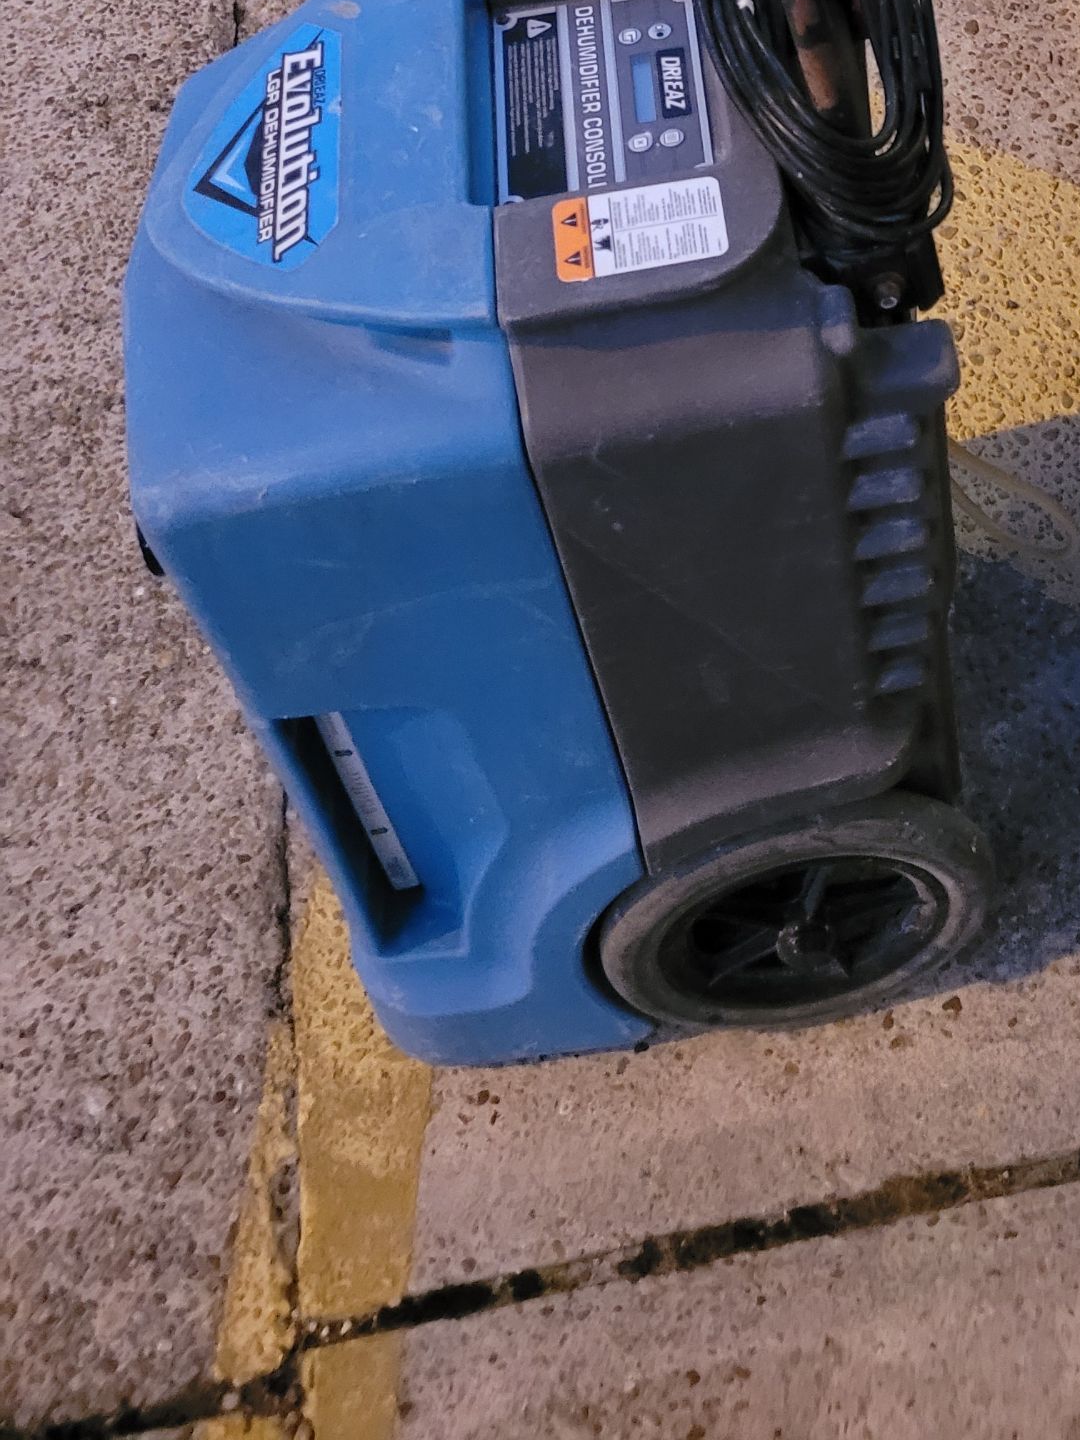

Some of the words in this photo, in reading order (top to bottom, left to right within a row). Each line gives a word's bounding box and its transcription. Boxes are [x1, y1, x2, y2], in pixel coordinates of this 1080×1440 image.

[266, 68, 282, 105] LGR
[575, 5, 601, 114] DEHUMIDIFIER
[659, 56, 686, 110] DRIEAZ
[257, 107, 279, 243] DEHUMIDIFIER
[273, 42, 323, 261] Evolution
